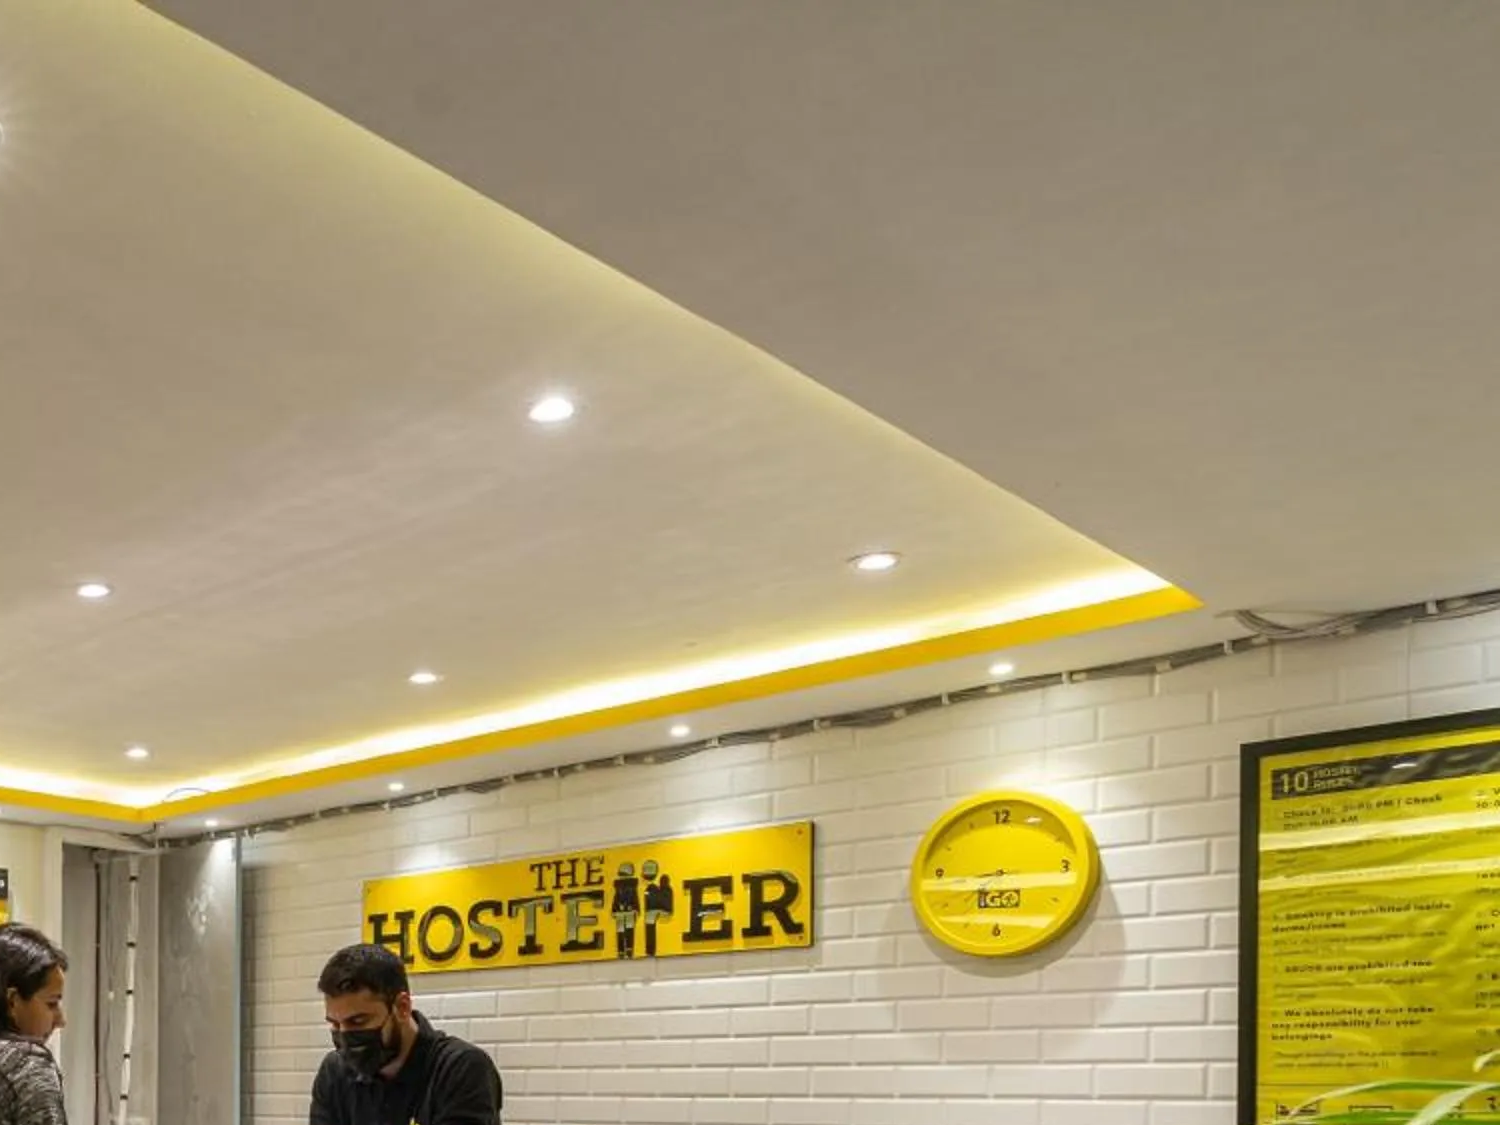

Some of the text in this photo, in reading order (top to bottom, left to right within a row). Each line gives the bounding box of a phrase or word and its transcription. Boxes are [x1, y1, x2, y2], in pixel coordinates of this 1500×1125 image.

[1281, 771, 1309, 793] 10
[992, 810, 1011, 824] 12
[1061, 859, 1070, 873] 3
[529, 856, 606, 891] THE
[991, 923, 1001, 937] 6
